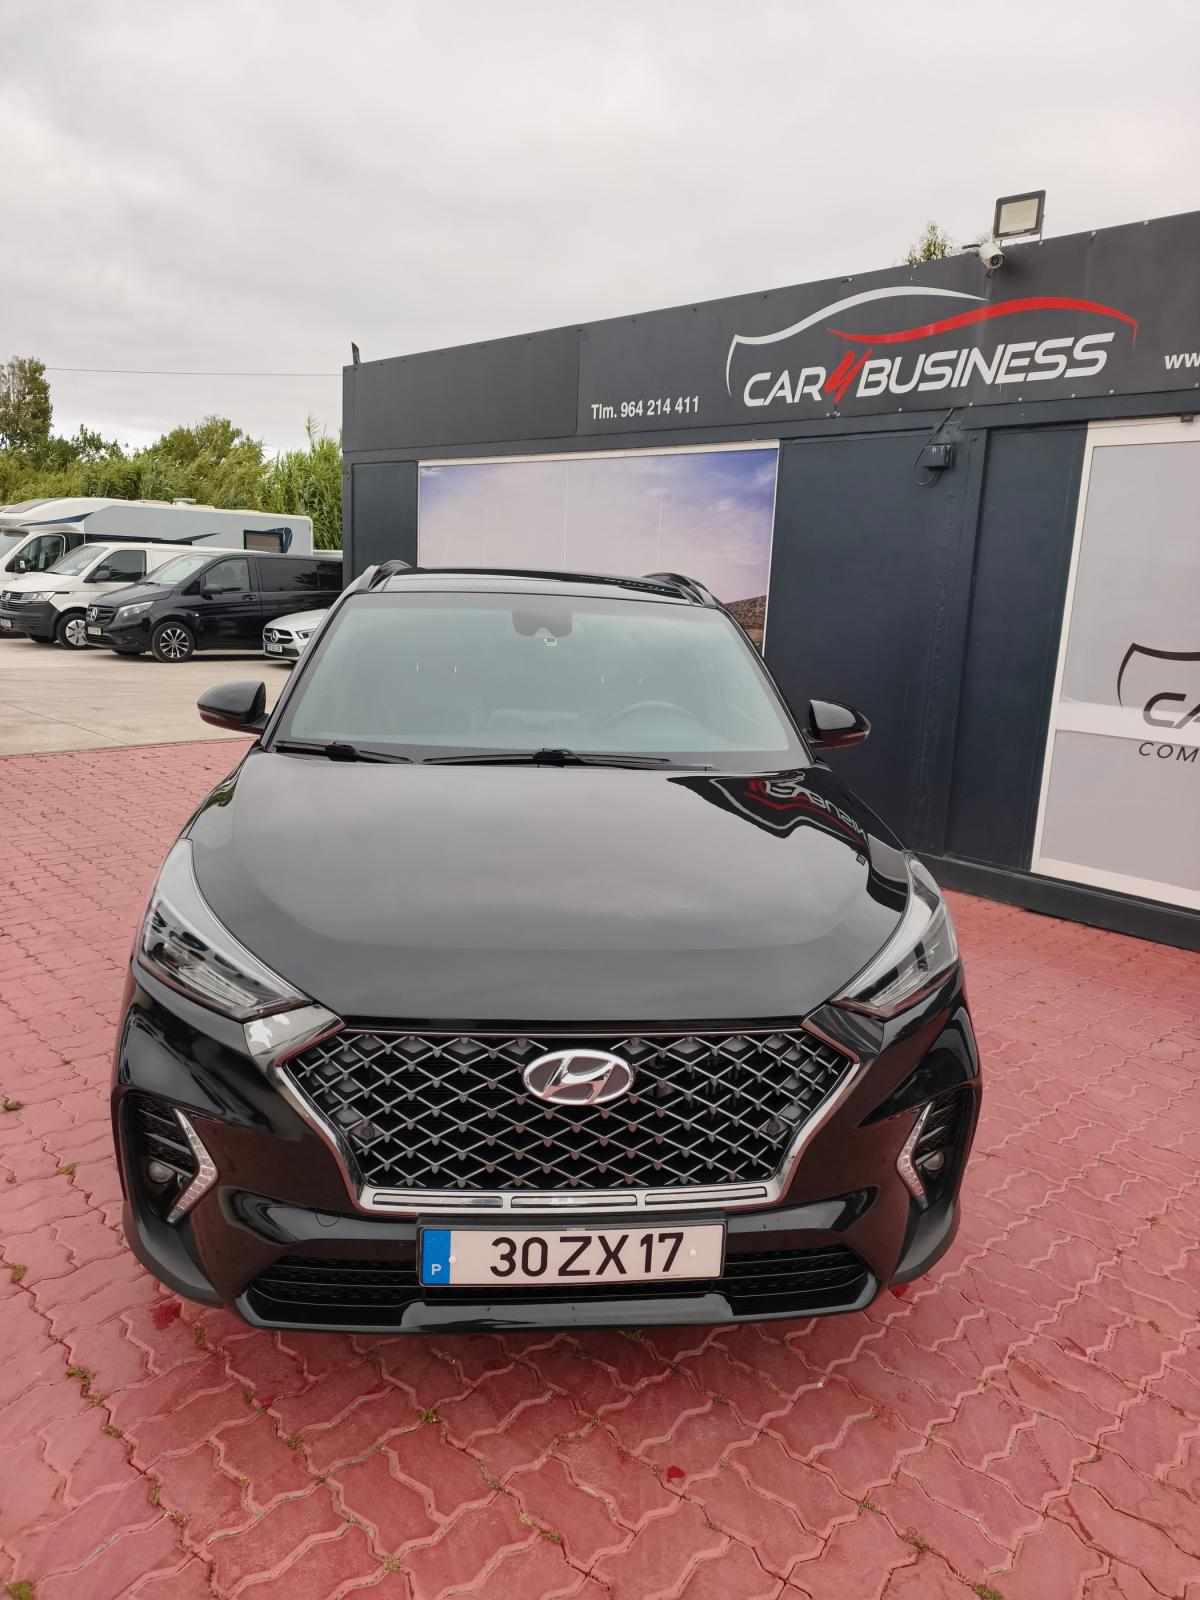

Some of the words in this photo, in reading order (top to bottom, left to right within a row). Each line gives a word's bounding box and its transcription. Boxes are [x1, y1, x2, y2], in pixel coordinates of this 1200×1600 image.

[620, 400, 643, 418] 964
[647, 398, 671, 416] 214
[675, 395, 699, 413] 411
[431, 1263, 442, 1276] P
